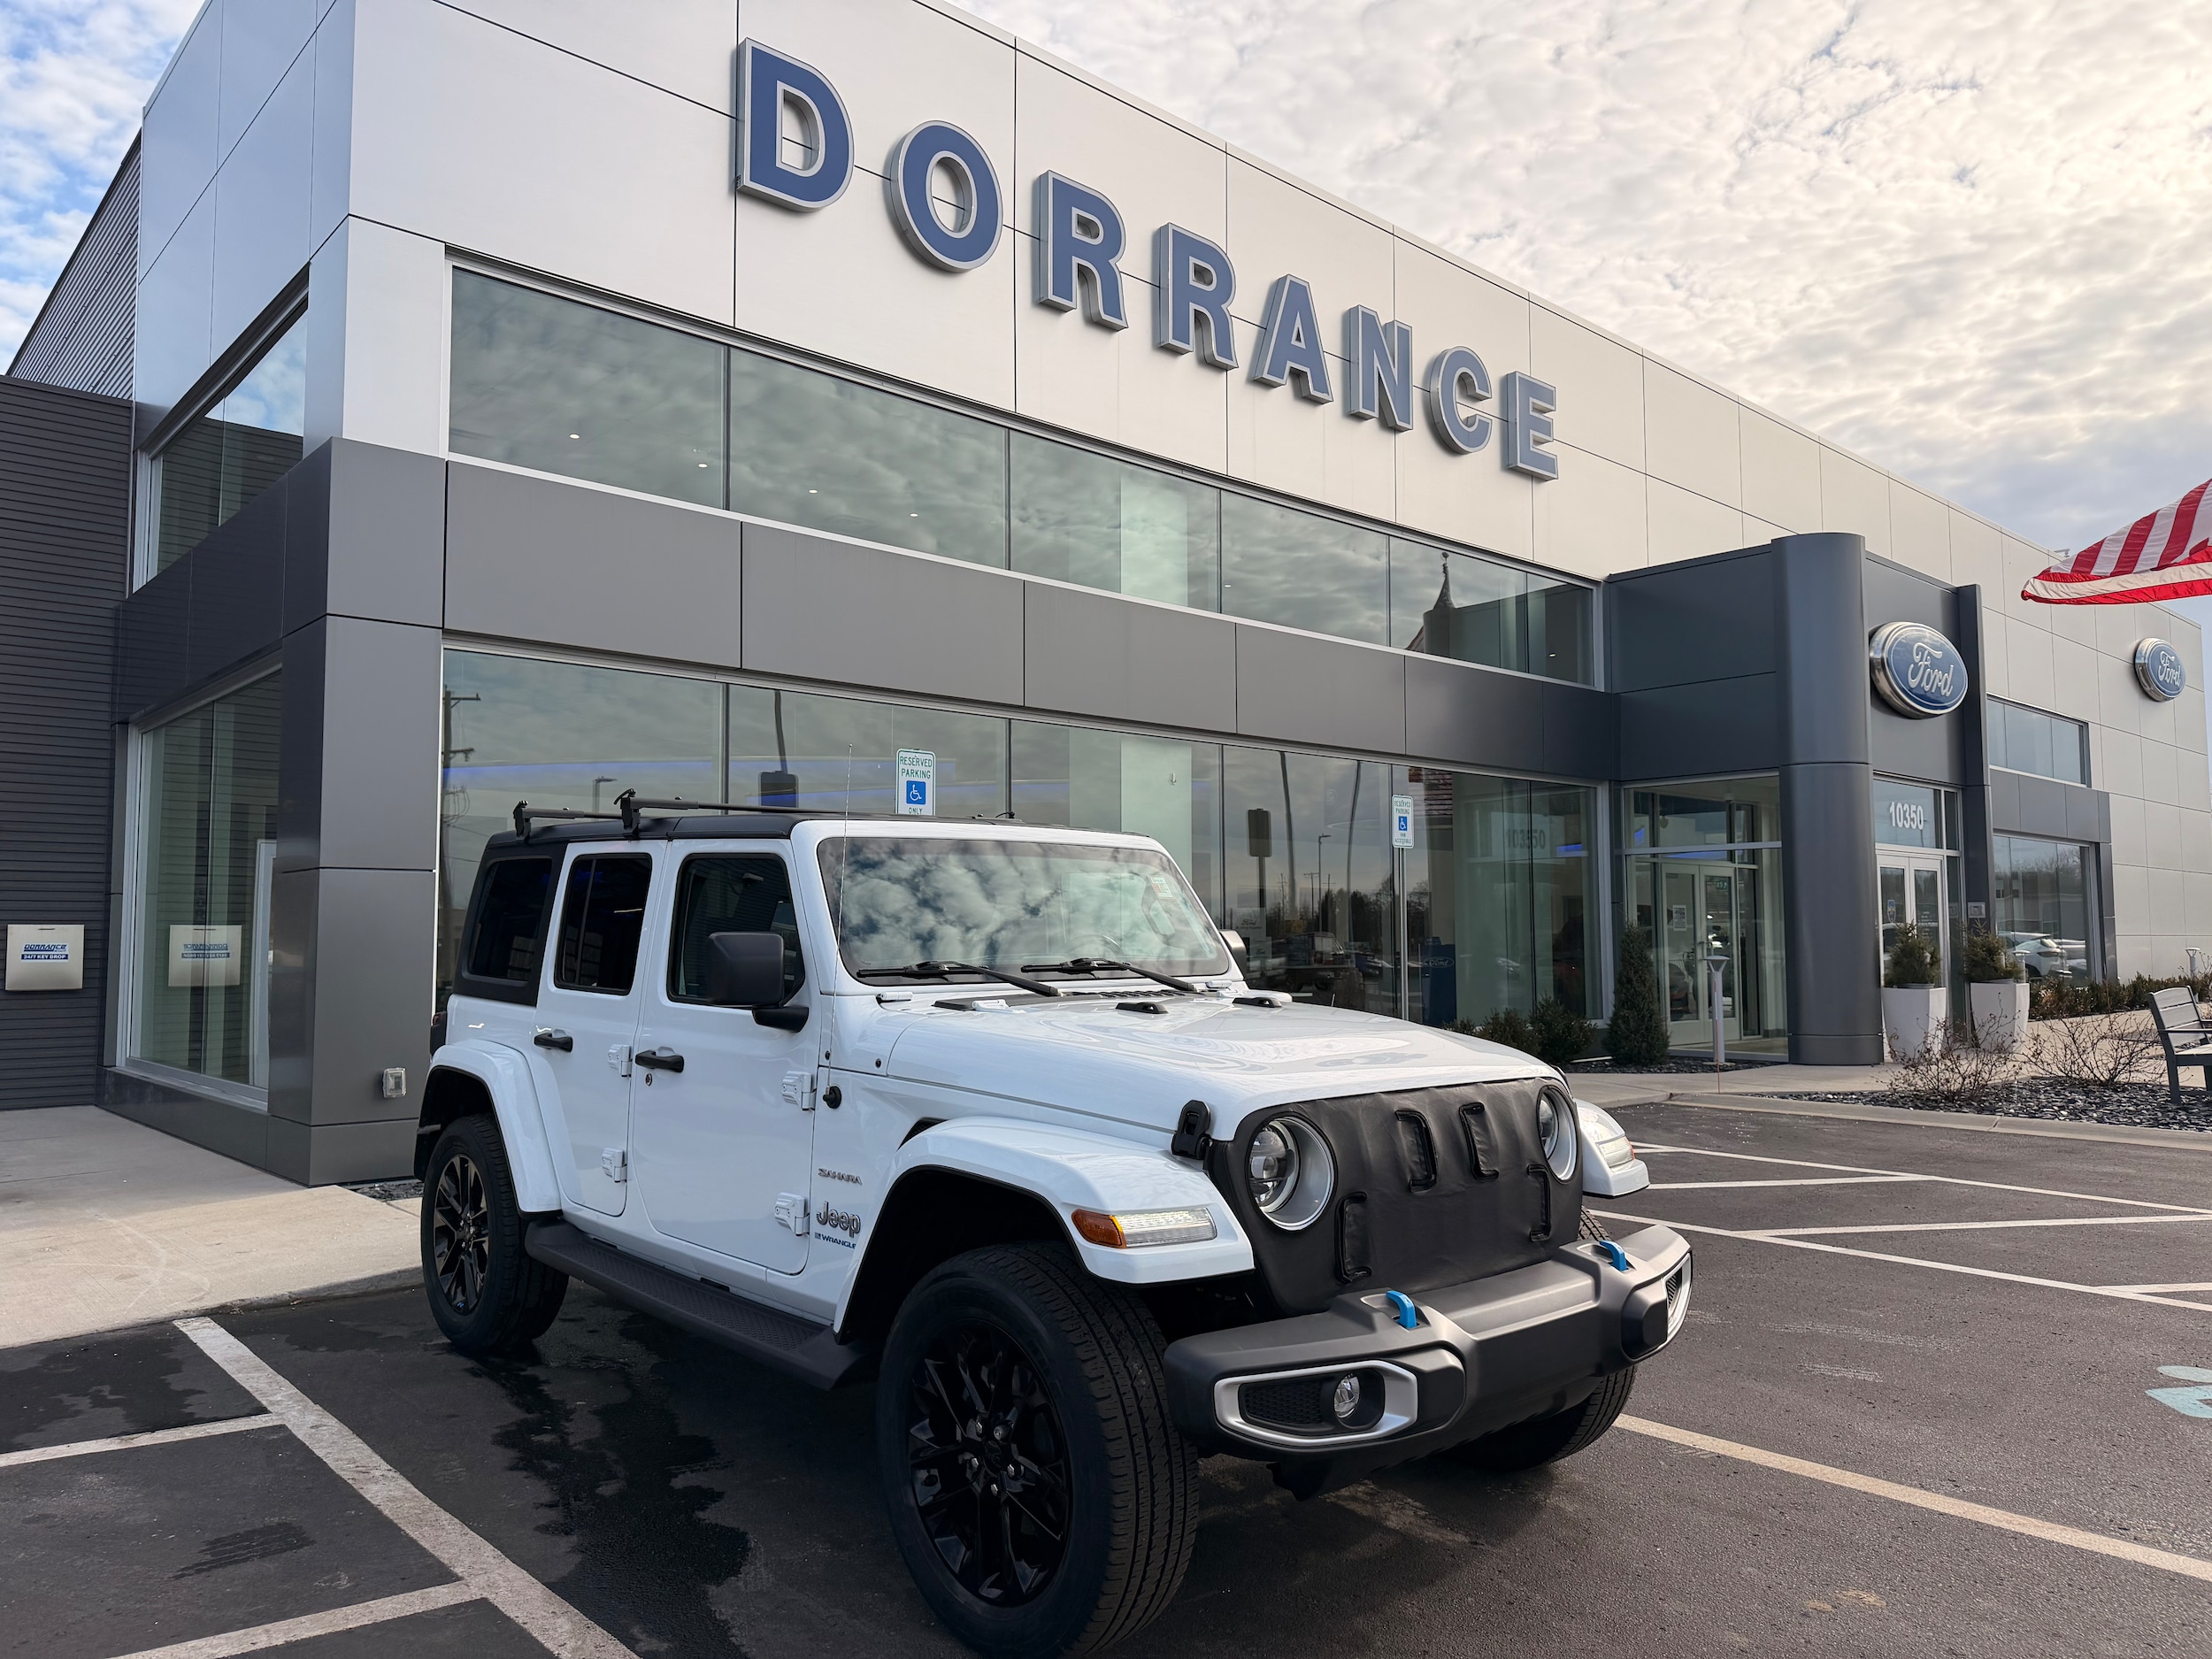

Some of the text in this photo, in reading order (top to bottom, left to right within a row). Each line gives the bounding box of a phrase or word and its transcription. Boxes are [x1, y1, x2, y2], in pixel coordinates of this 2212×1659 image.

[736, 37, 1559, 481] DORRANCE
[1908, 642, 1955, 697] Ford
[2159, 650, 2181, 687] Ford
[900, 757, 932, 767] RESERVED
[902, 769, 931, 779] PARKING
[1889, 801, 1924, 830] 10350
[23, 943, 67, 952] DORRANCE
[818, 1168, 863, 1186] SAHARA
[816, 1200, 862, 1239] Jeep
[821, 1233, 856, 1249] WRANGLE
